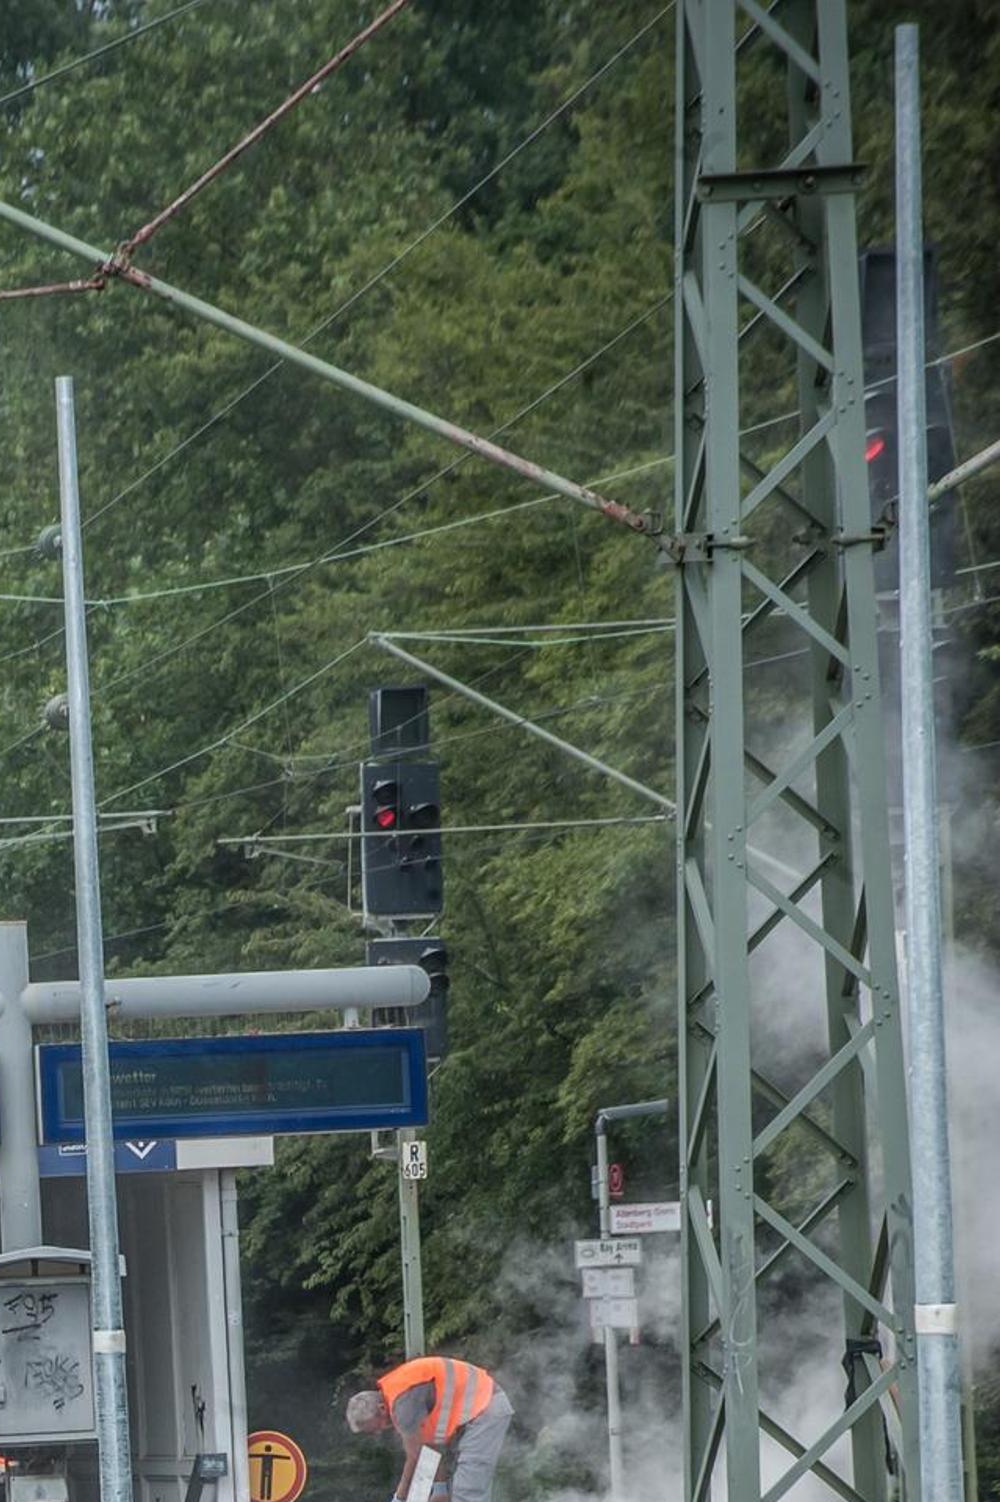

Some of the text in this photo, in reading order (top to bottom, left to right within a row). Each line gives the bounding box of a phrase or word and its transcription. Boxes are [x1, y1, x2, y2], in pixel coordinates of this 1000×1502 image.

[111, 1071, 157, 1084] wetter
[410, 1144, 419, 1162] R
[403, 1163, 426, 1177] 605
